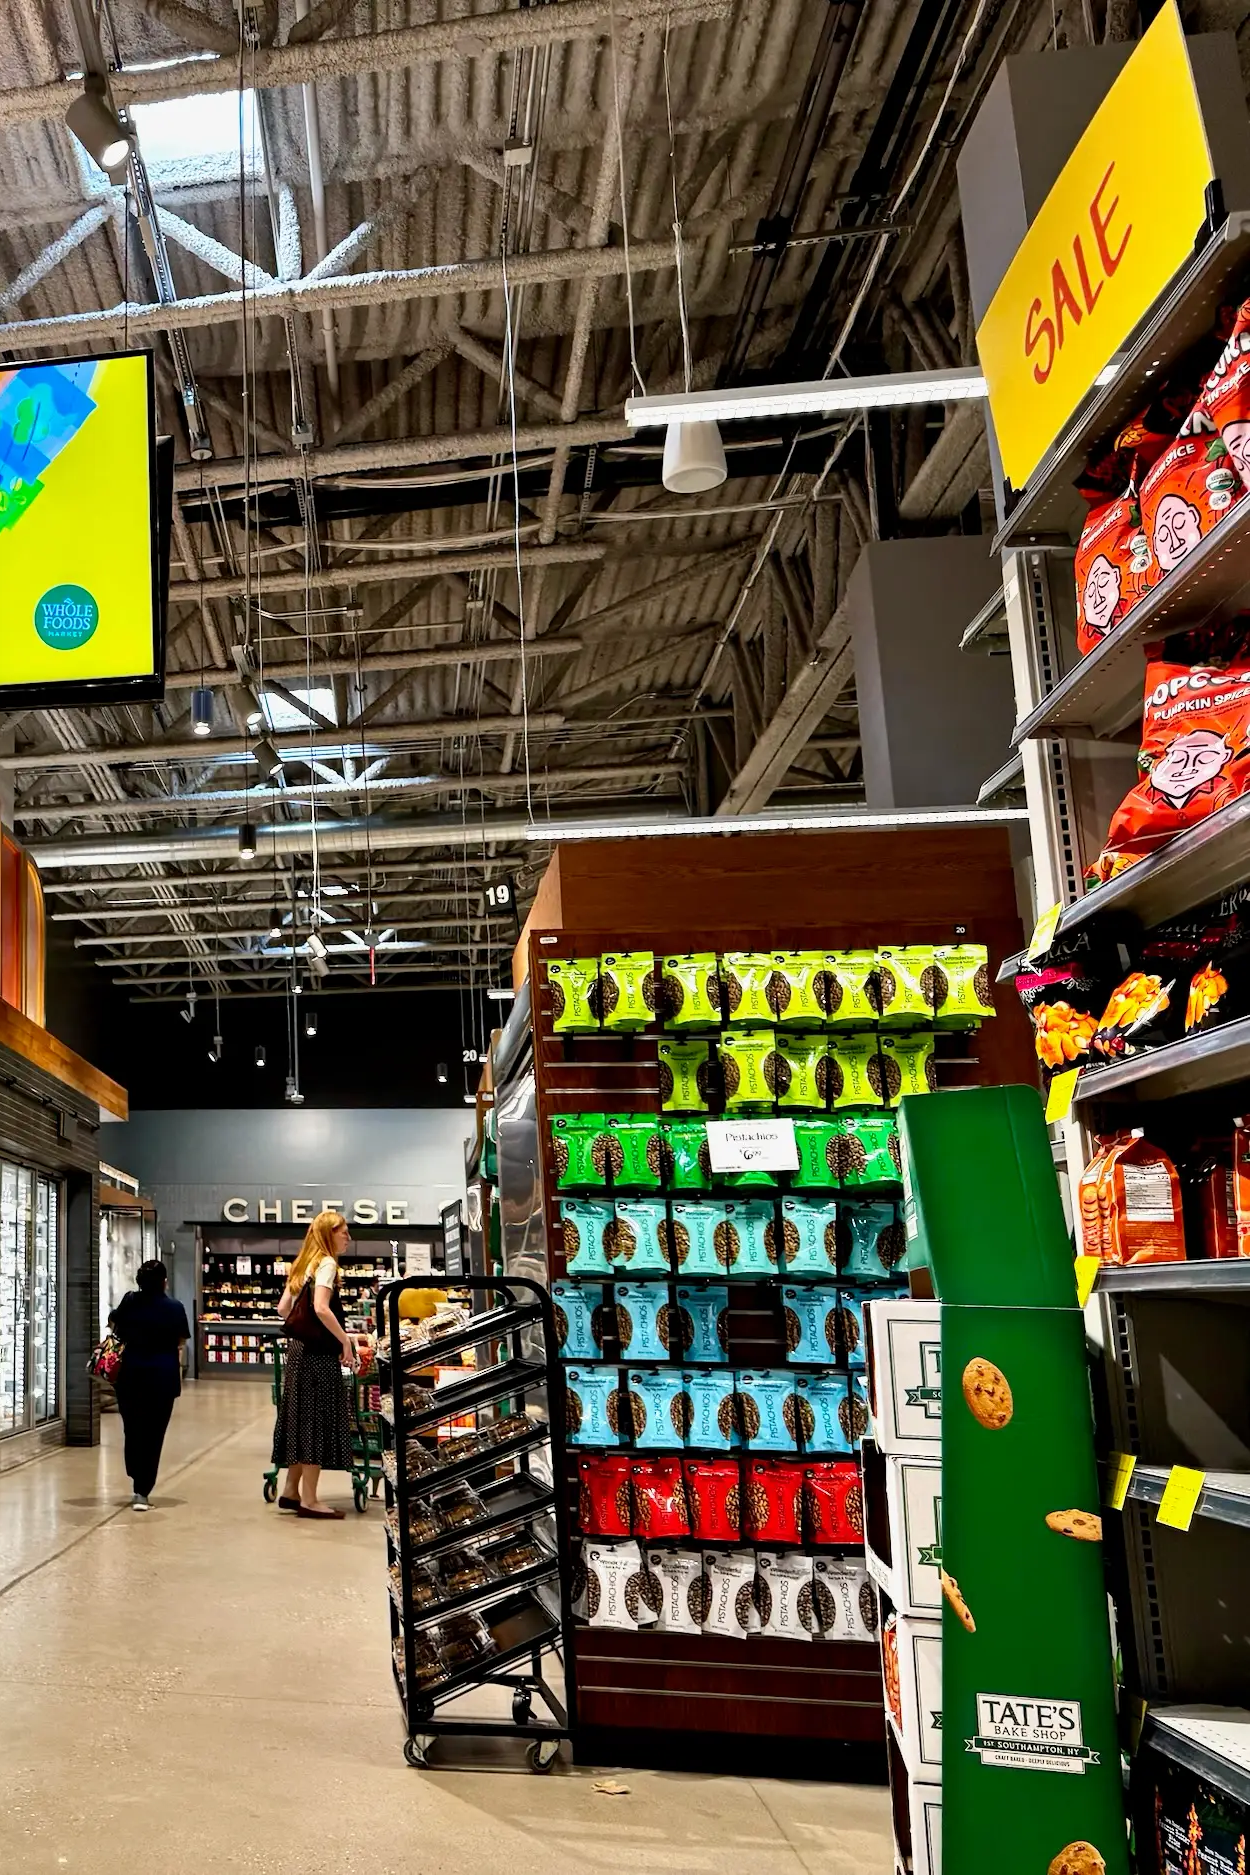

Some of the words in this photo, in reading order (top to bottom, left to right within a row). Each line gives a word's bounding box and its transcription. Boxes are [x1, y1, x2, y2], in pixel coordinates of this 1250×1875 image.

[1025, 160, 1132, 385] SALE
[42, 604, 94, 616] WHOLE
[44, 616, 90, 630] FOODS
[1154, 697, 1210, 720] PUMPKIN
[486, 884, 510, 906] 19
[462, 1050, 478, 1062] 20
[748, 1053, 758, 1094] PISTACHIOS
[852, 1054, 861, 1096] PISTACHIOS
[682, 1062, 690, 1102] PISTACHIOS
[630, 1134, 639, 1180] PISTACHIOS
[725, 1132, 778, 1142] Pistachios
[810, 1134, 818, 1178] PISTACHIOS
[588, 1220, 597, 1262] PISTACHIOS
[646, 1218, 654, 1258] PISTACHIOS
[698, 1220, 706, 1263] PISTACHIOS
[748, 1219, 756, 1263] PISTACHIOS
[702, 1308, 710, 1351] PISTACHIOS
[810, 1308, 818, 1352] PISTACHIOS
[590, 1388, 600, 1434] PISTACHIOS
[701, 1392, 709, 1436] PISTACHIOS
[770, 1392, 780, 1439] PISTACHIOS
[824, 1396, 834, 1440] PISTACHIOS
[608, 1571, 618, 1616] PISTACHIOS
[670, 1574, 680, 1622] PISTACHIOS
[716, 1578, 732, 1624] PISTACHIOS
[780, 1580, 790, 1628] PISTACHIOS
[840, 1582, 854, 1630] PISTACHIOS
[982, 1700, 1076, 1730] TATE'S
[994, 1725, 1028, 1738] BAKE
[1033, 1728, 1066, 1741] SHOP
[998, 1742, 1066, 1755] SOUTHAMPTON,
